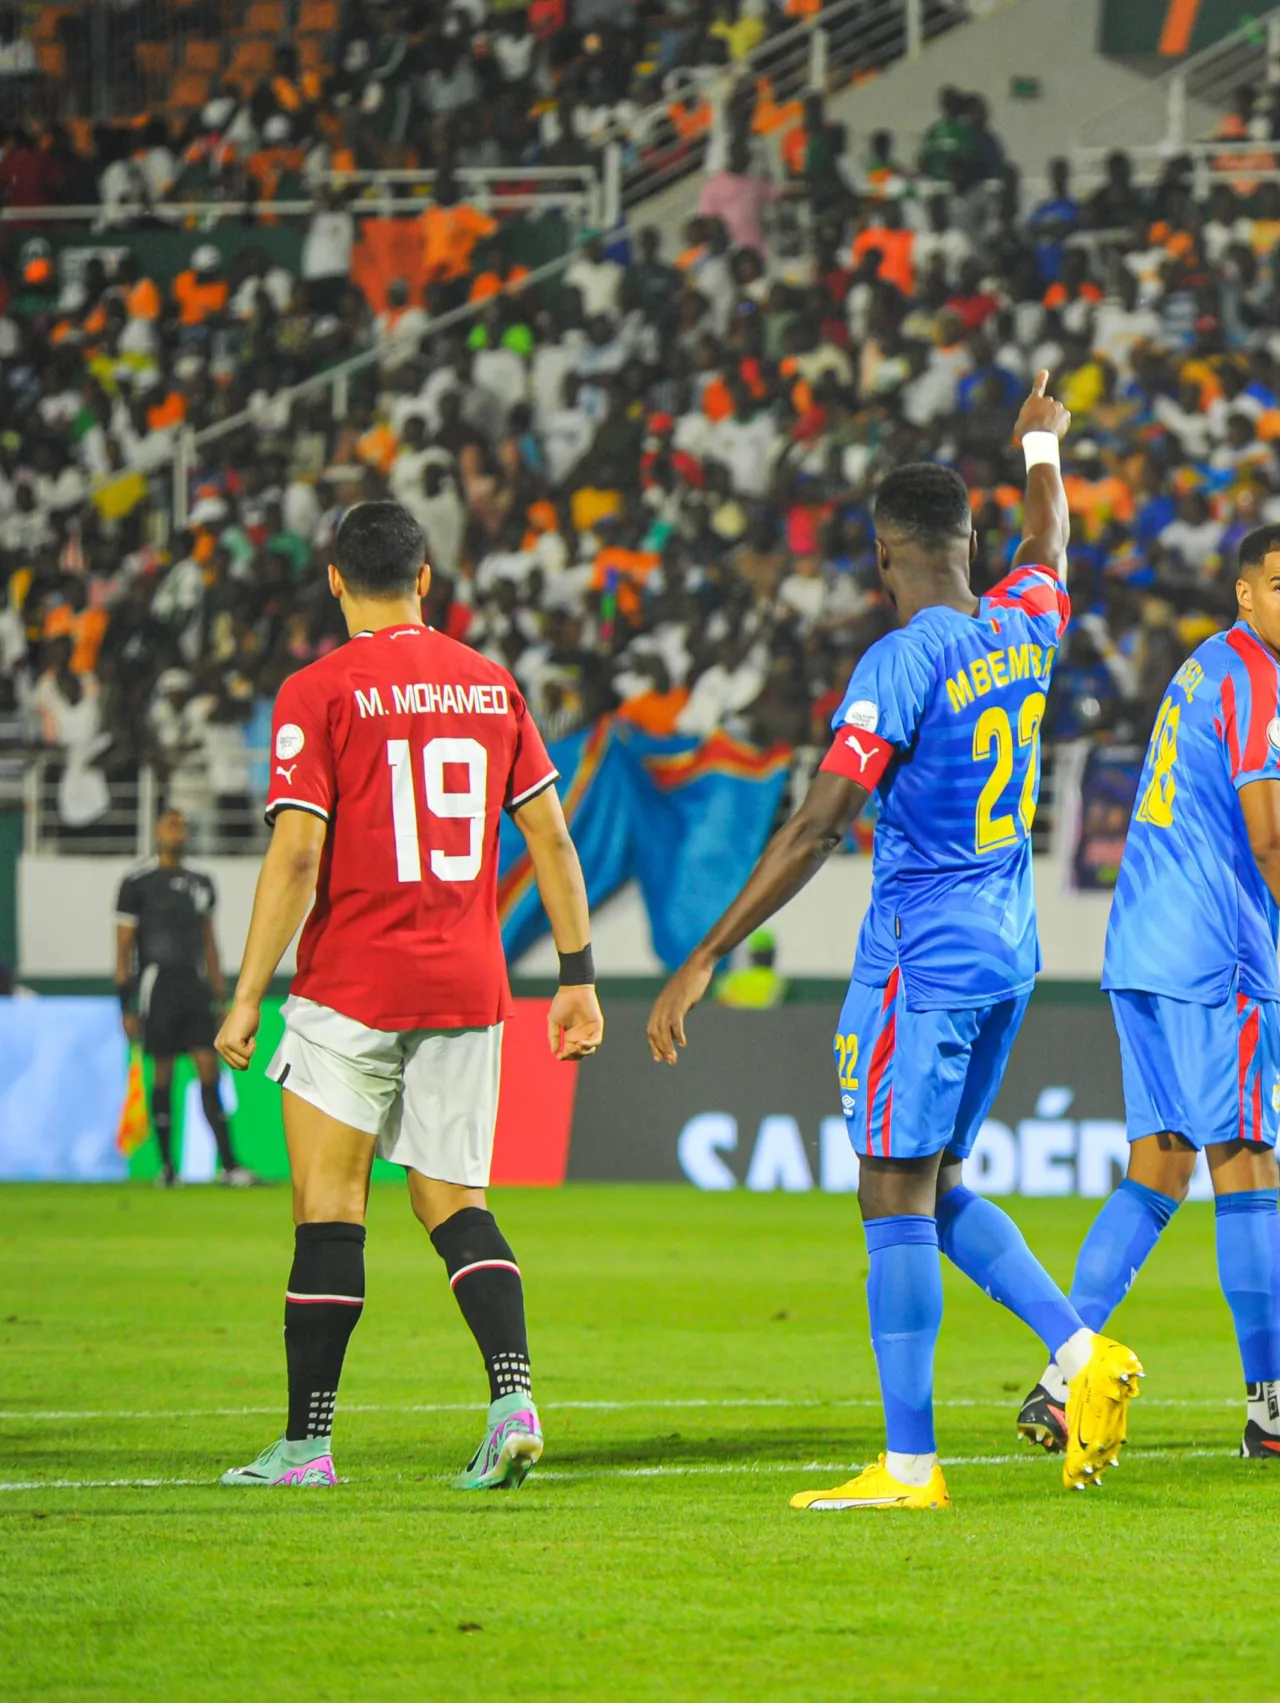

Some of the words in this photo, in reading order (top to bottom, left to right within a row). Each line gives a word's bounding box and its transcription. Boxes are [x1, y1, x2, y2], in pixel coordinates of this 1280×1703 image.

[354, 687, 389, 719] M.
[391, 683, 509, 715] MOHAMED
[386, 737, 488, 883] 19
[972, 691, 1046, 855] 22
[834, 1033, 859, 1091] 22
